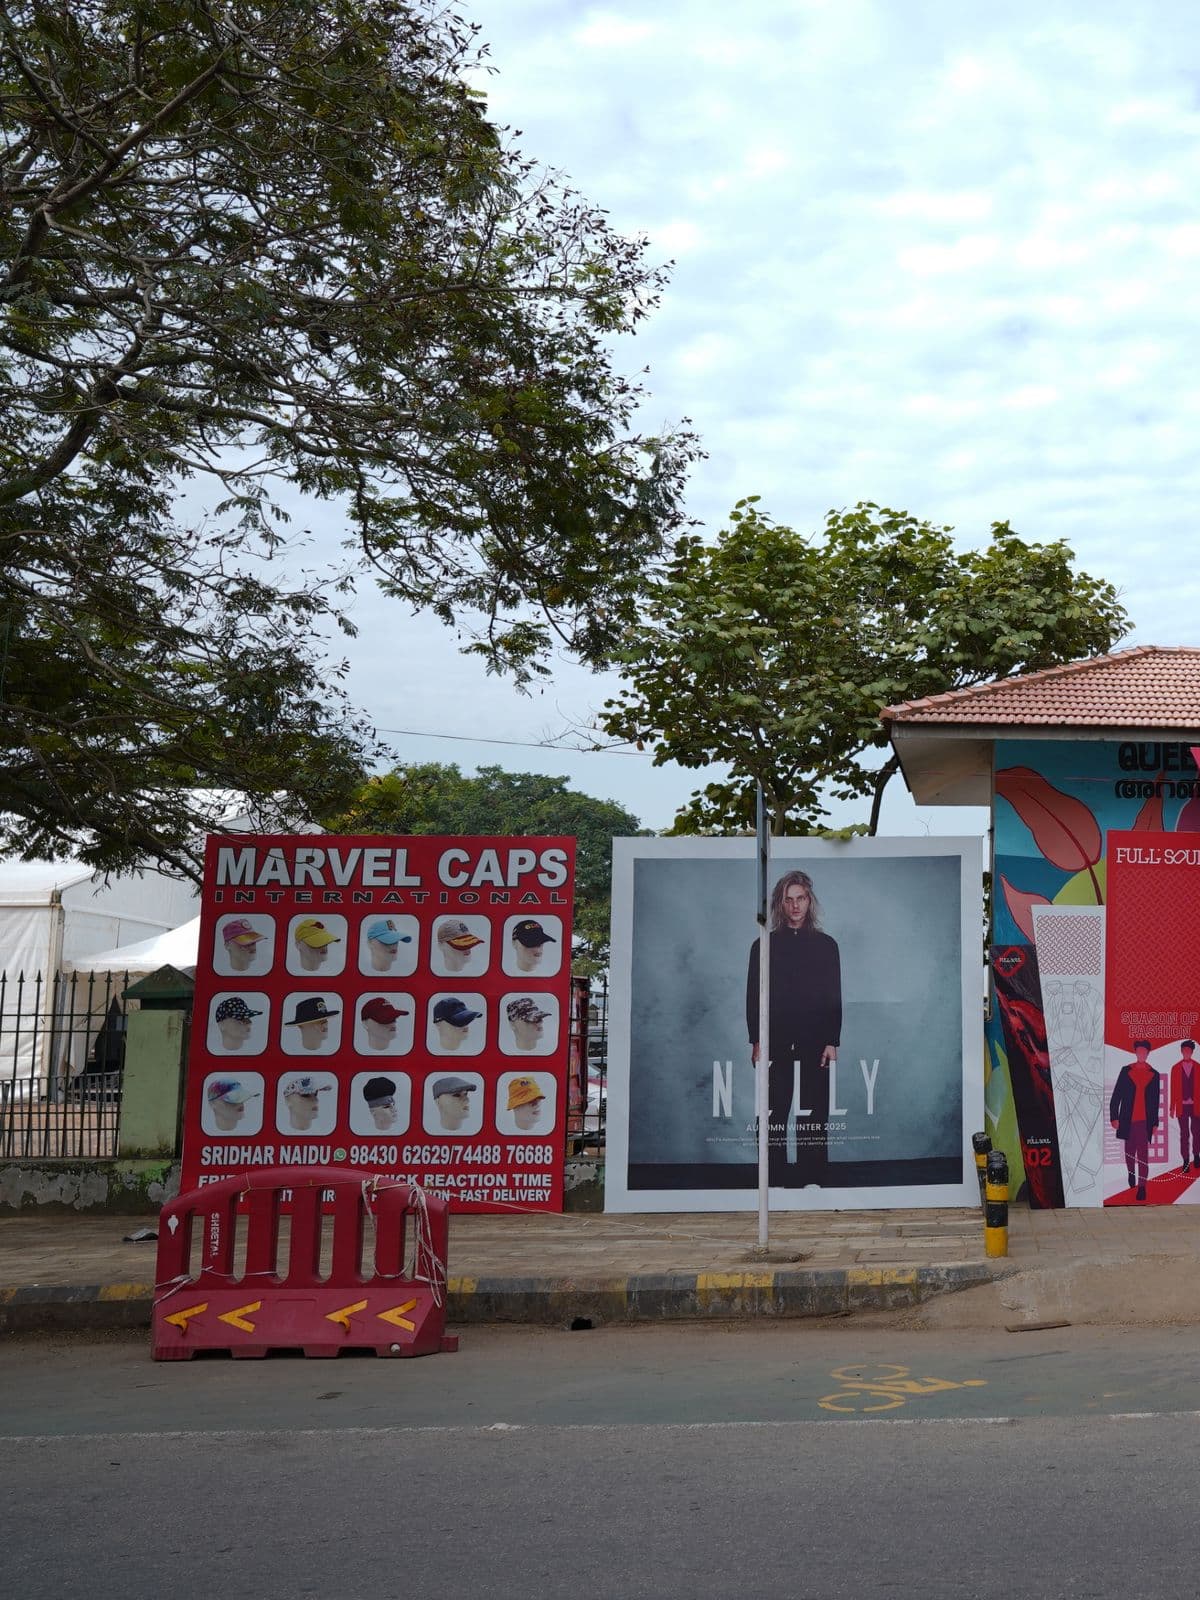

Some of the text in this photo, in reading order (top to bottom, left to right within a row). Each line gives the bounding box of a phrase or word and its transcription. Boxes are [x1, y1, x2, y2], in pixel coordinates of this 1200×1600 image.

[1115, 848, 1161, 865] FULL
[215, 847, 569, 889] MARVEL CAPS
[214, 890, 568, 905] INTERNATIONAL
[1121, 1011, 1199, 1025] SEASON OF
[1128, 1025, 1191, 1039] FASHION
[787, 1123, 822, 1131] WINTER
[824, 1122, 847, 1131] 2025
[201, 1144, 553, 1165] SRIDHAR NAIDU 98430 62629/74488 76688
[1027, 1148, 1052, 1166] 02
[424, 1173, 507, 1187] REACTION
[512, 1173, 552, 1187] TIME
[460, 1189, 491, 1202] FAST
[493, 1189, 551, 1202] DELIVERY
